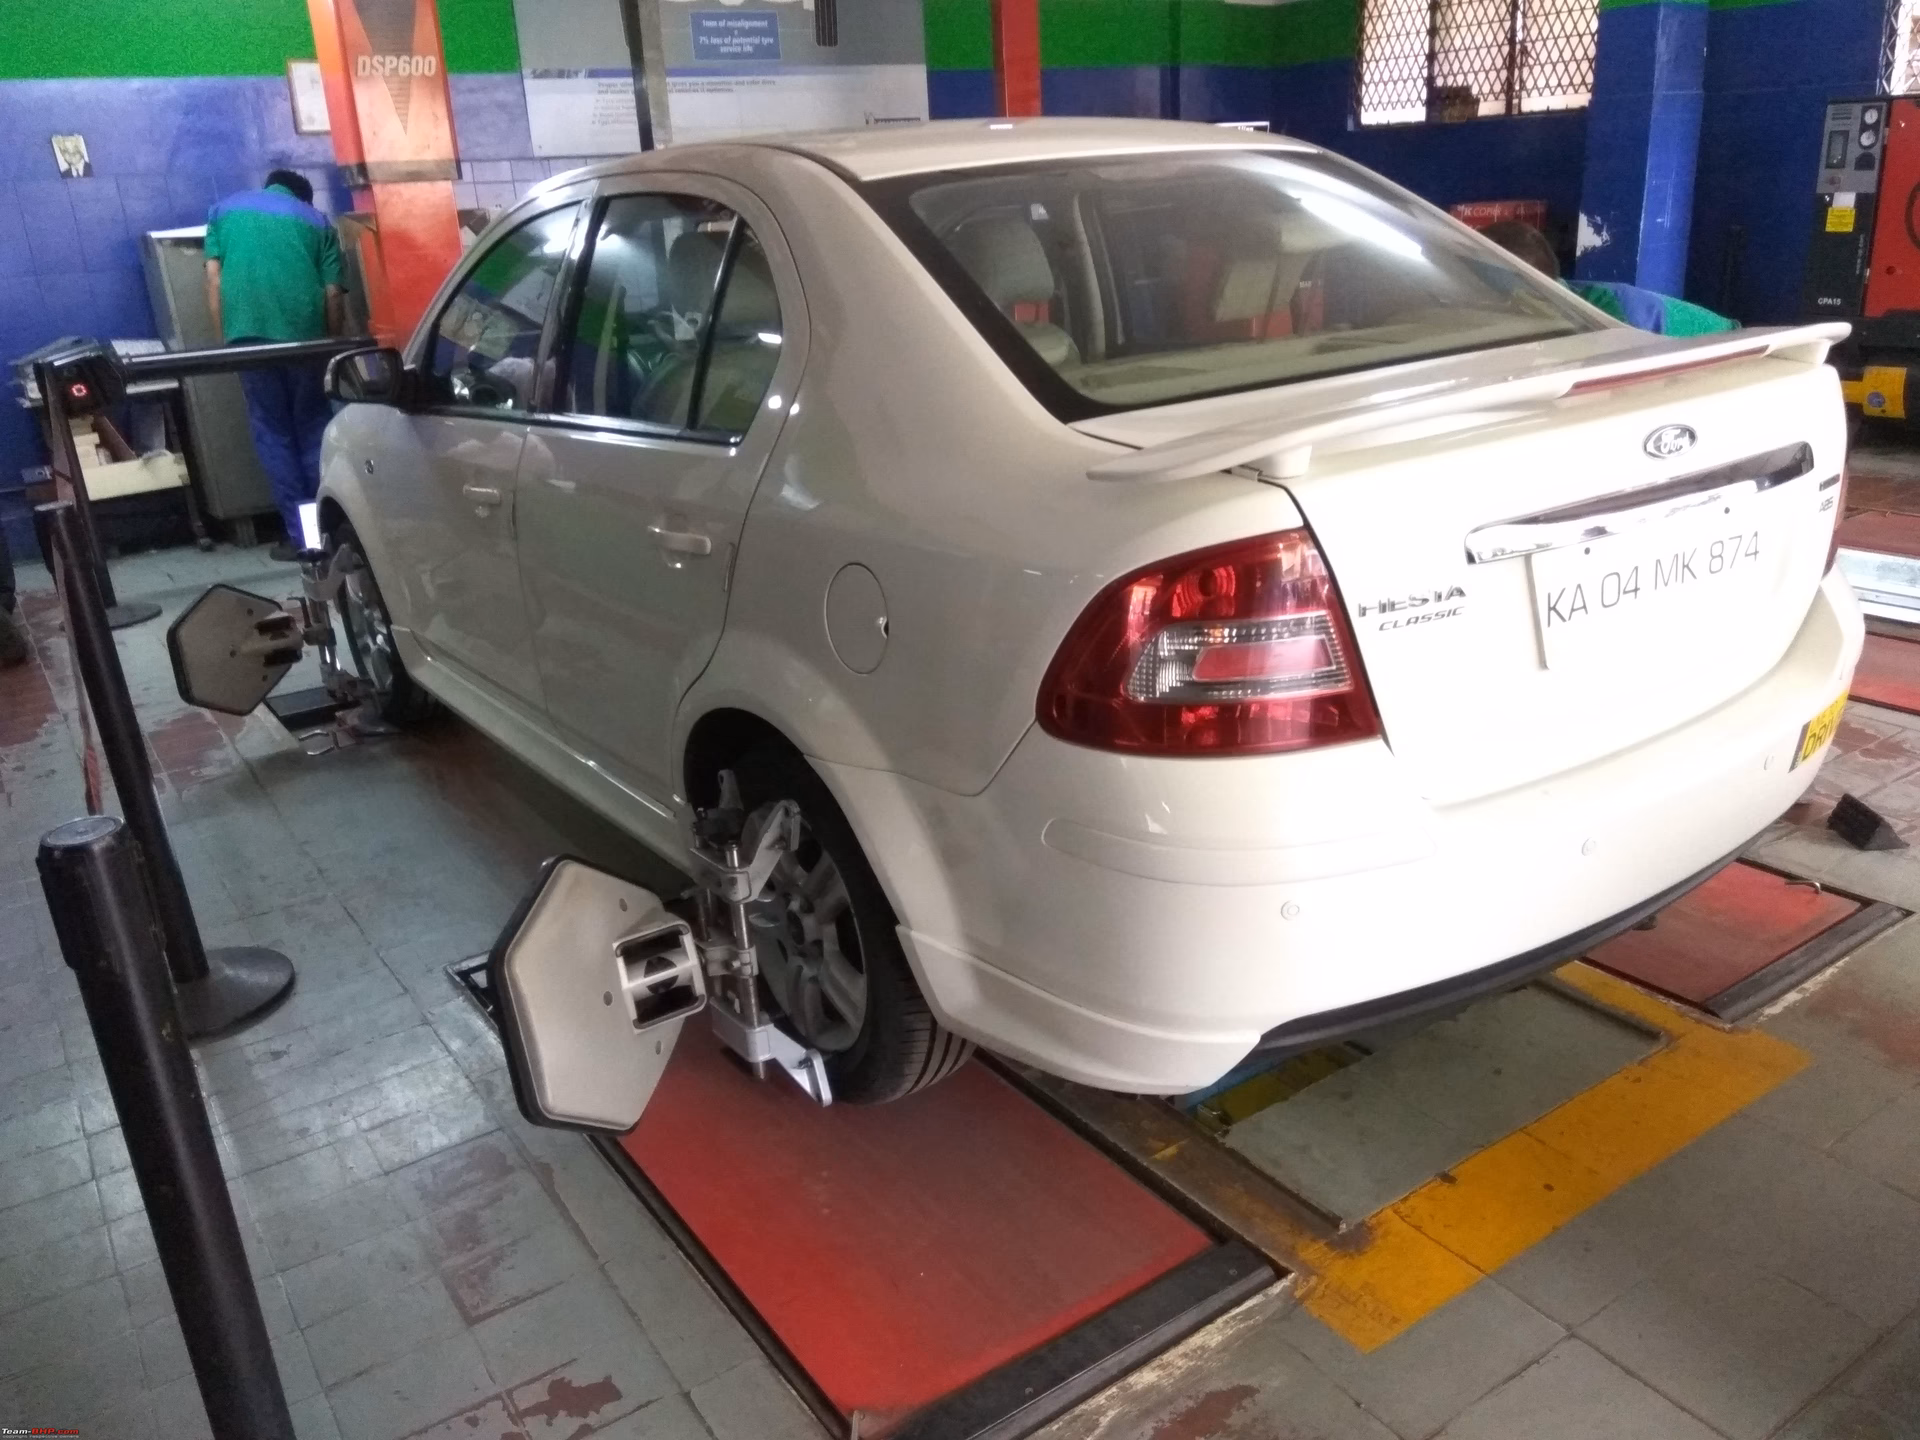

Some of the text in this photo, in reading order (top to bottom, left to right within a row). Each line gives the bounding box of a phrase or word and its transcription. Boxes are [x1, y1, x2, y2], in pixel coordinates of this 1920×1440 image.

[718, 19, 726, 28] of
[727, 19, 768, 30] misalignment
[723, 35, 731, 45] of
[732, 36, 760, 47] potential
[761, 36, 774, 46] tyre
[720, 46, 742, 54] service
[357, 54, 437, 77] DSP600
[1817, 297, 1842, 306] CPA15
[1547, 530, 1760, 628] KA 04 MK 874
[1358, 585, 1467, 618] FIESTA
[1378, 606, 1466, 631] CLASSIC
